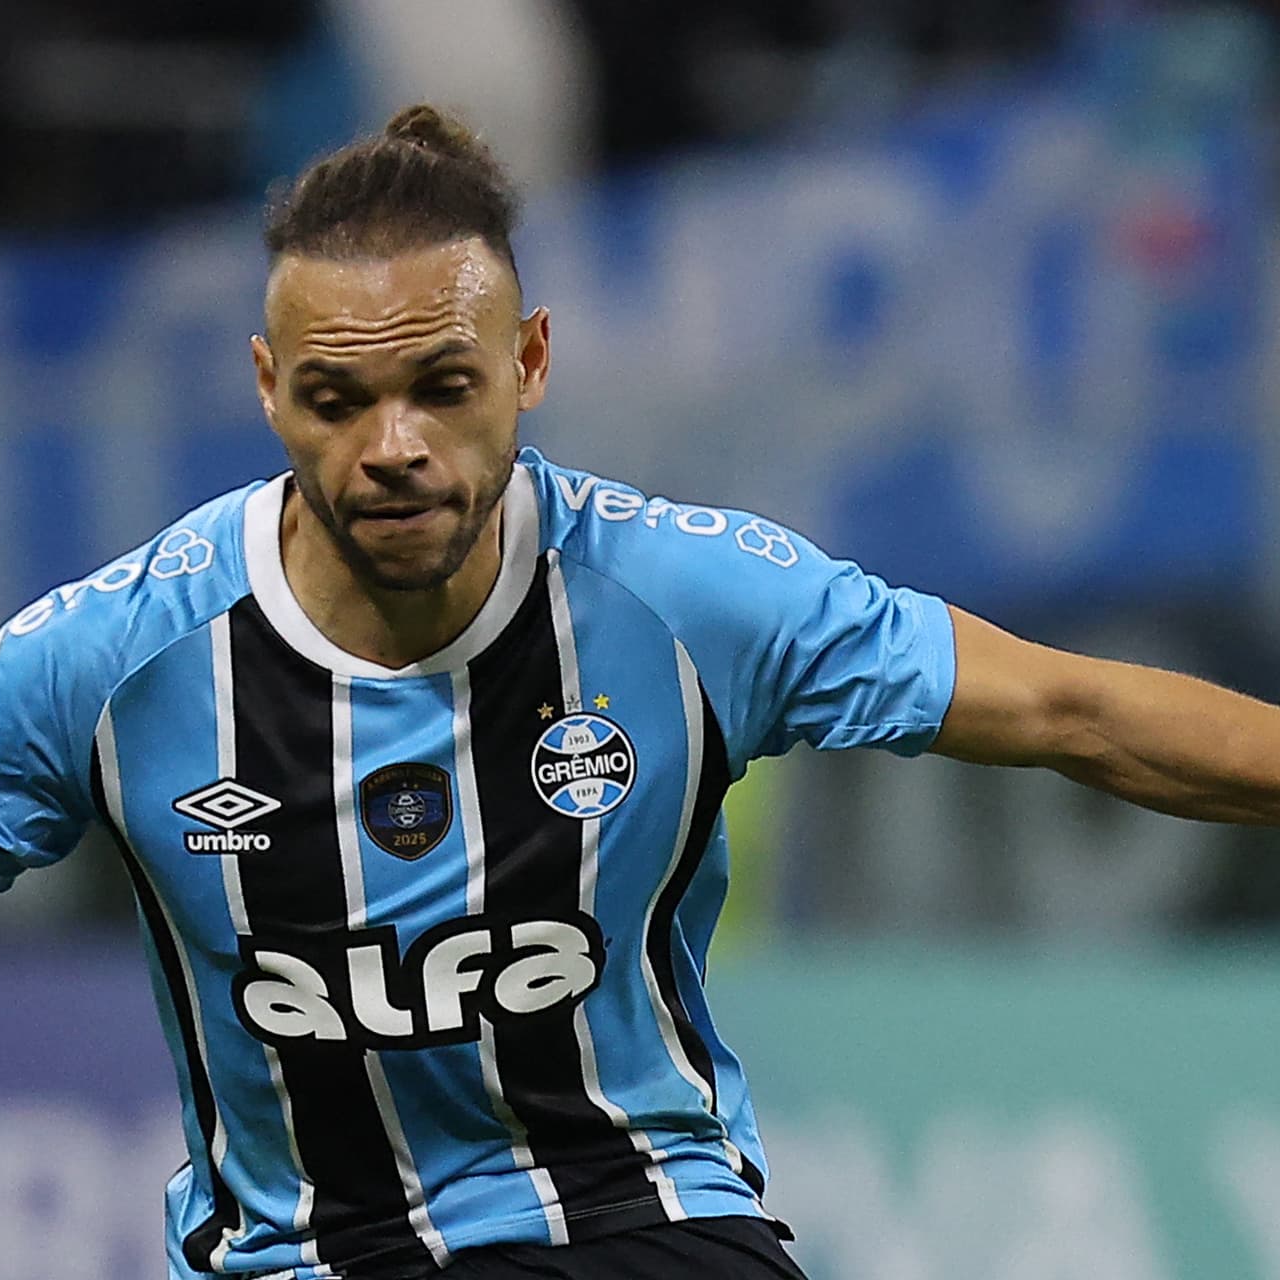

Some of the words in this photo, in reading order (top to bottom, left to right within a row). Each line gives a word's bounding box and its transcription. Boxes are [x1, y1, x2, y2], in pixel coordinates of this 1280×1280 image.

[538, 752, 628, 784] GRÊMIO
[187, 829, 271, 851] umbro
[393, 832, 428, 847] 2025
[242, 920, 597, 1041] alfa
